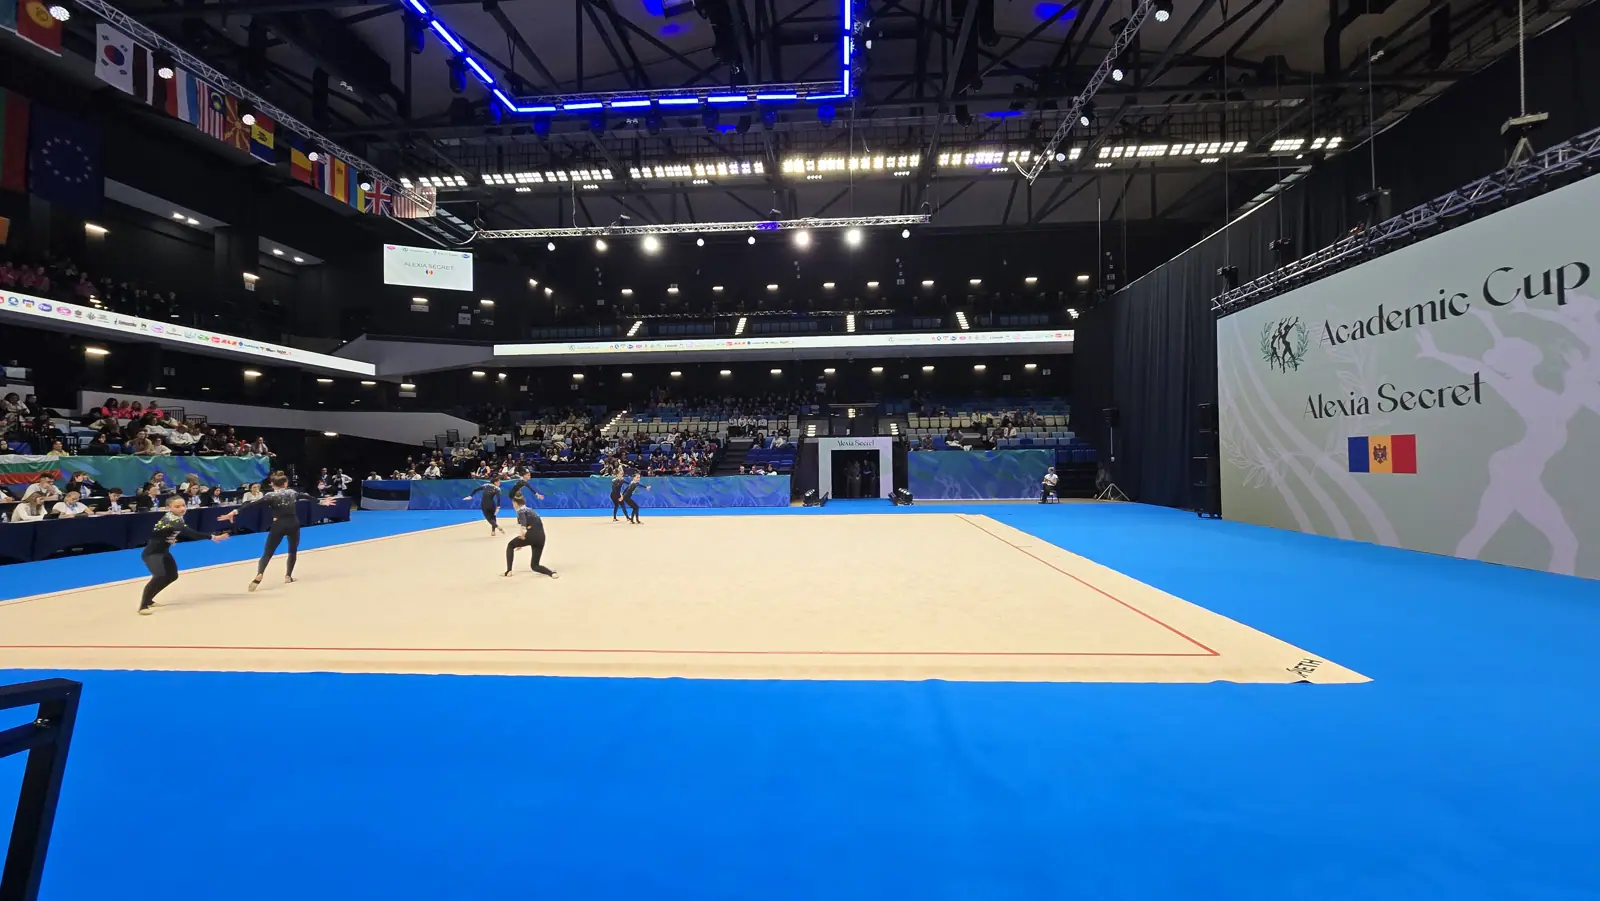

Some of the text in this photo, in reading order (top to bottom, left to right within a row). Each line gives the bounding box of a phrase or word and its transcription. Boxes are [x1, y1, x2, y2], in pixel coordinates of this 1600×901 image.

[404, 261, 455, 271] ALEXIA SECRET
[1318, 261, 1591, 349] Academic Cup
[1304, 371, 1486, 419] Alexia Secret
